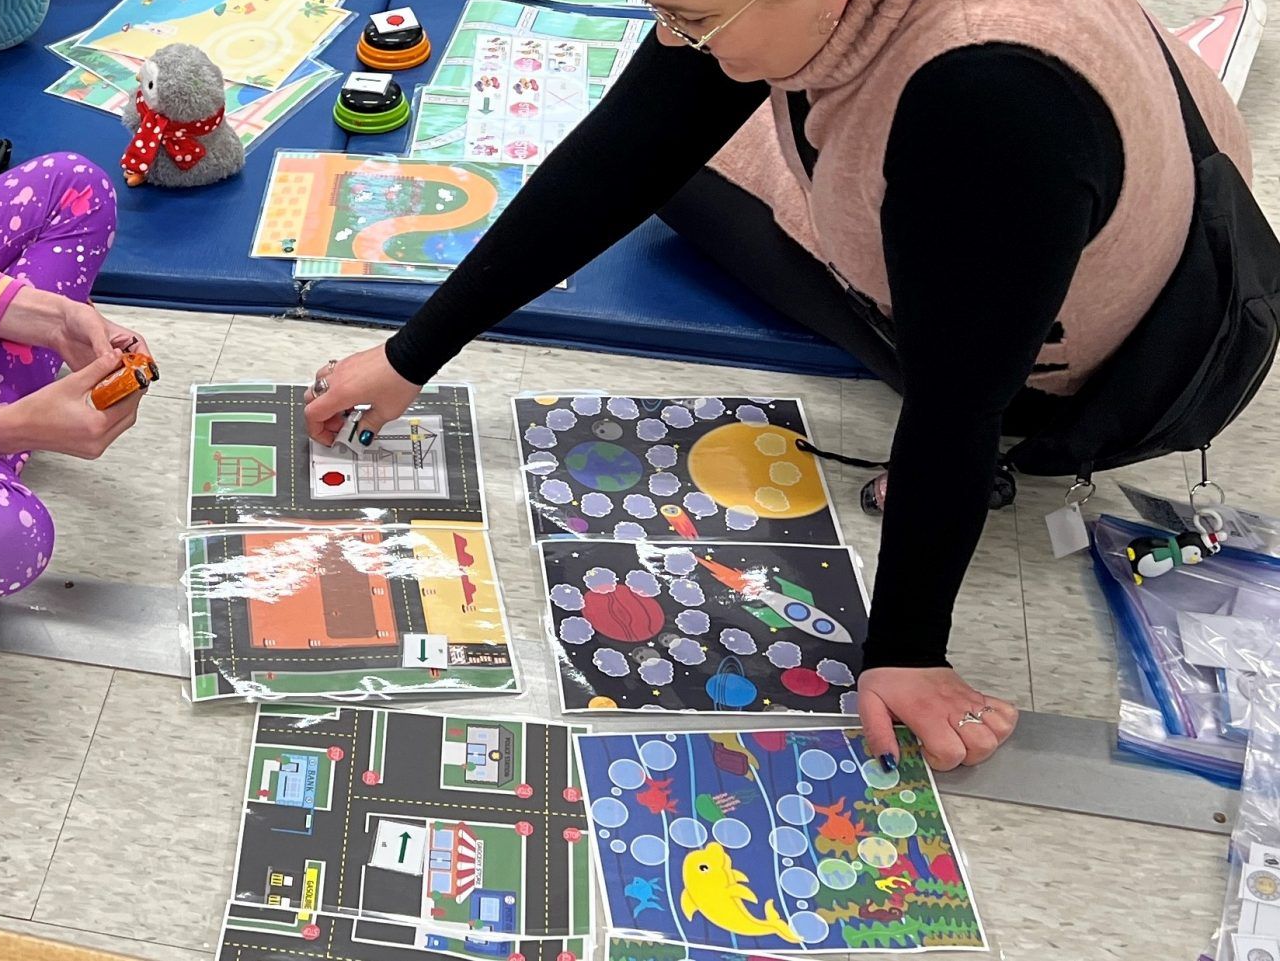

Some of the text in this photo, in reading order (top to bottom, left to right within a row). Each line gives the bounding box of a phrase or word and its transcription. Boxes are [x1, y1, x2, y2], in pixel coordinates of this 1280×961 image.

[503, 756, 511, 778] STATION
[306, 769, 317, 792] BANK
[564, 829, 581, 840] STOP
